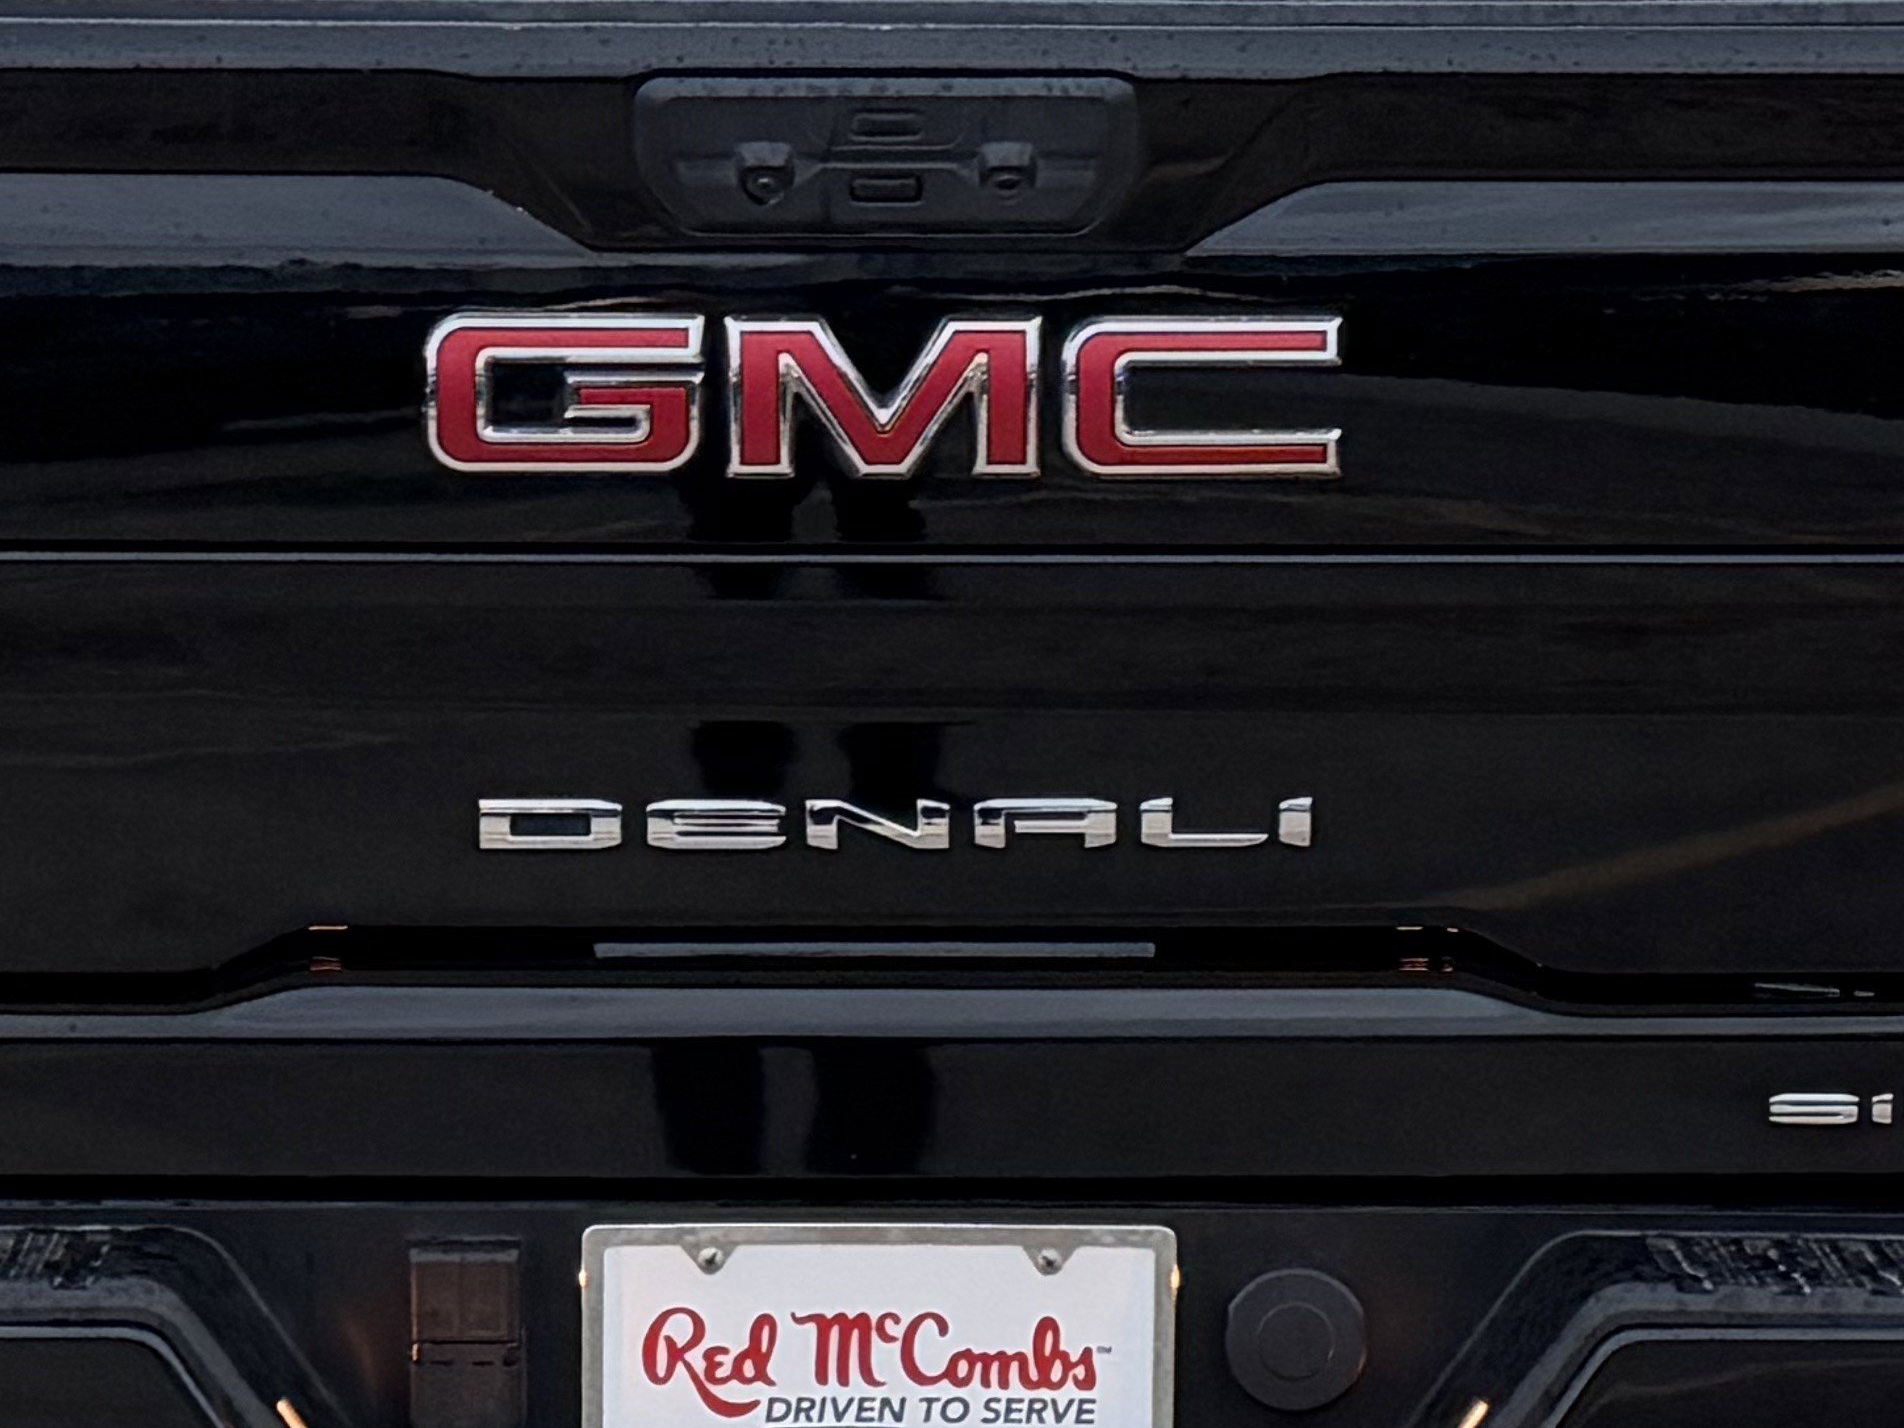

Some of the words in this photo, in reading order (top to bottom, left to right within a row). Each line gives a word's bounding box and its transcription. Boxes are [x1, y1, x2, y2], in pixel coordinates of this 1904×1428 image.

[424, 311, 1344, 480] GMC
[478, 797, 1313, 849] DENALI
[642, 1307, 778, 1418] Red
[791, 1312, 1096, 1391] McCombs
[766, 1397, 906, 1423] DRIVEN
[920, 1397, 970, 1424] TO
[981, 1397, 1096, 1425] SERVE
